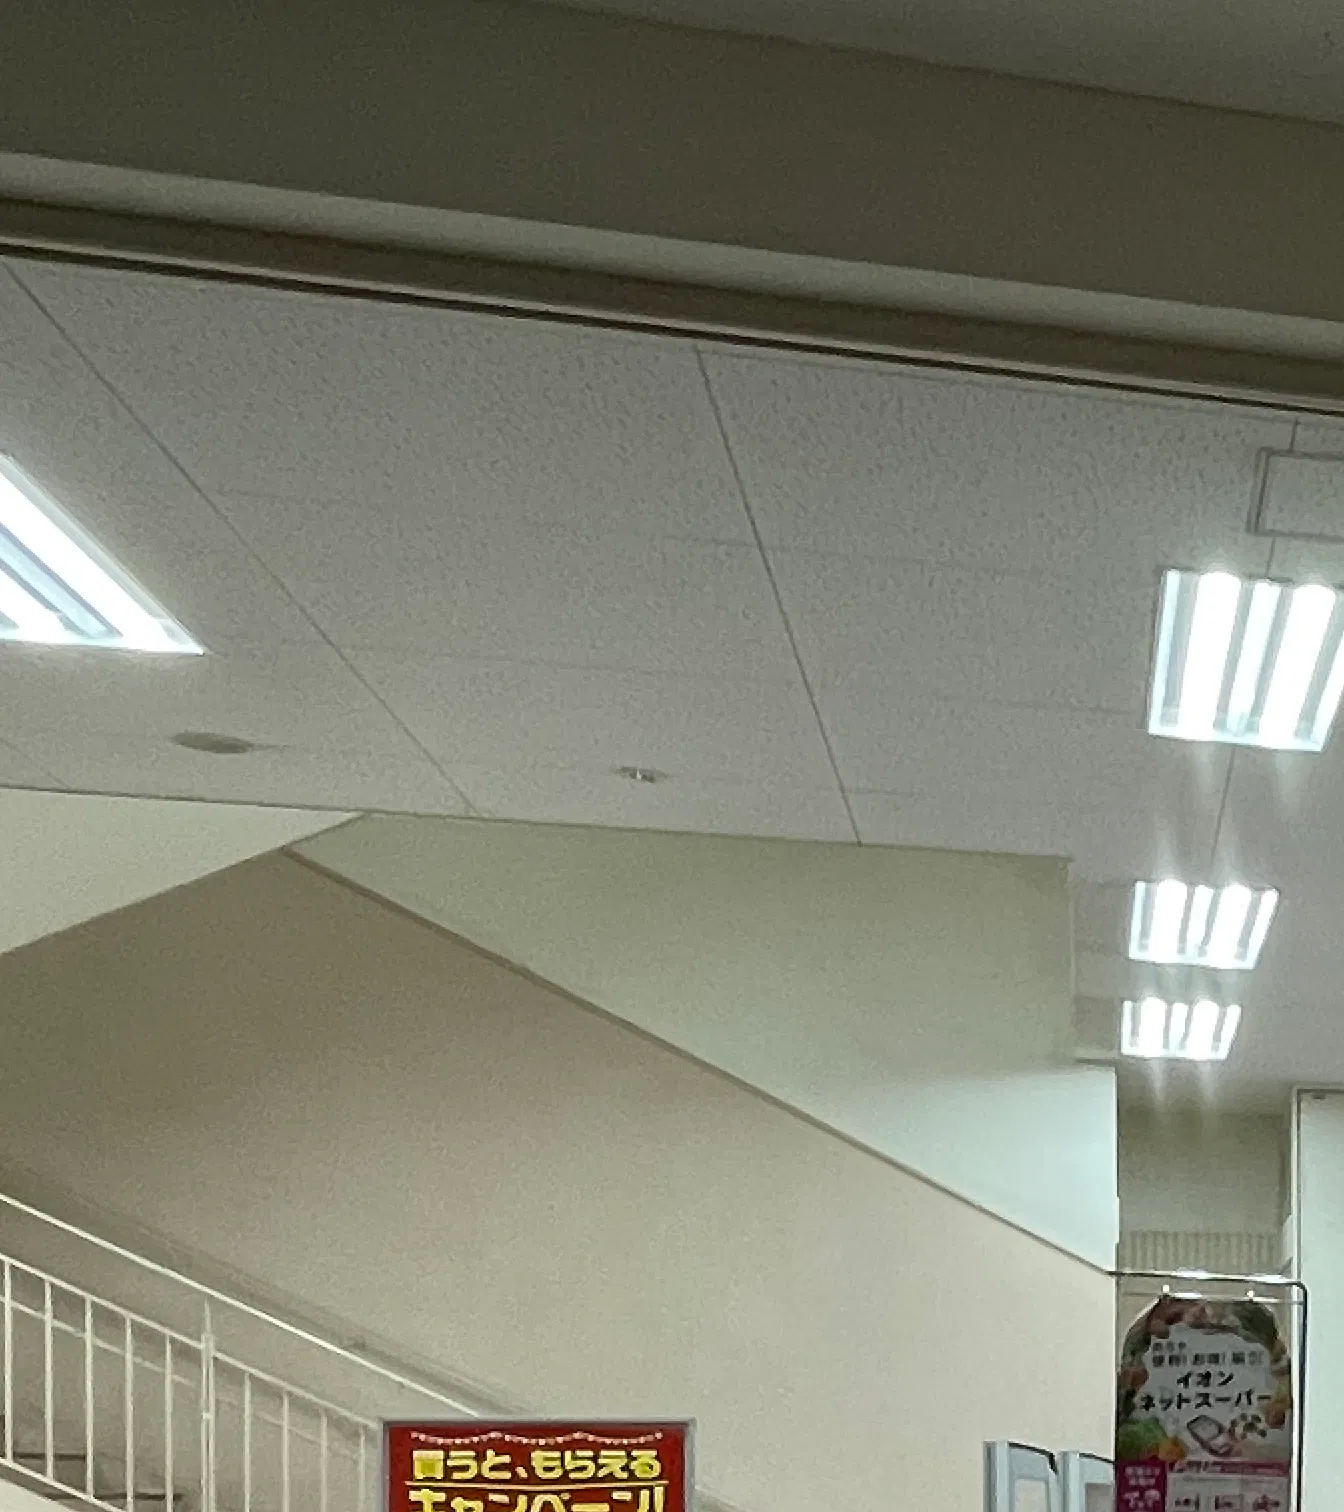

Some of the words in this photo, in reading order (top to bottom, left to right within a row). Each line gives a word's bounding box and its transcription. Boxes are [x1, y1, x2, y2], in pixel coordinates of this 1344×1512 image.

[1177, 1370, 1235, 1389] イオン
[1140, 1388, 1272, 1412] ネットスーパー
